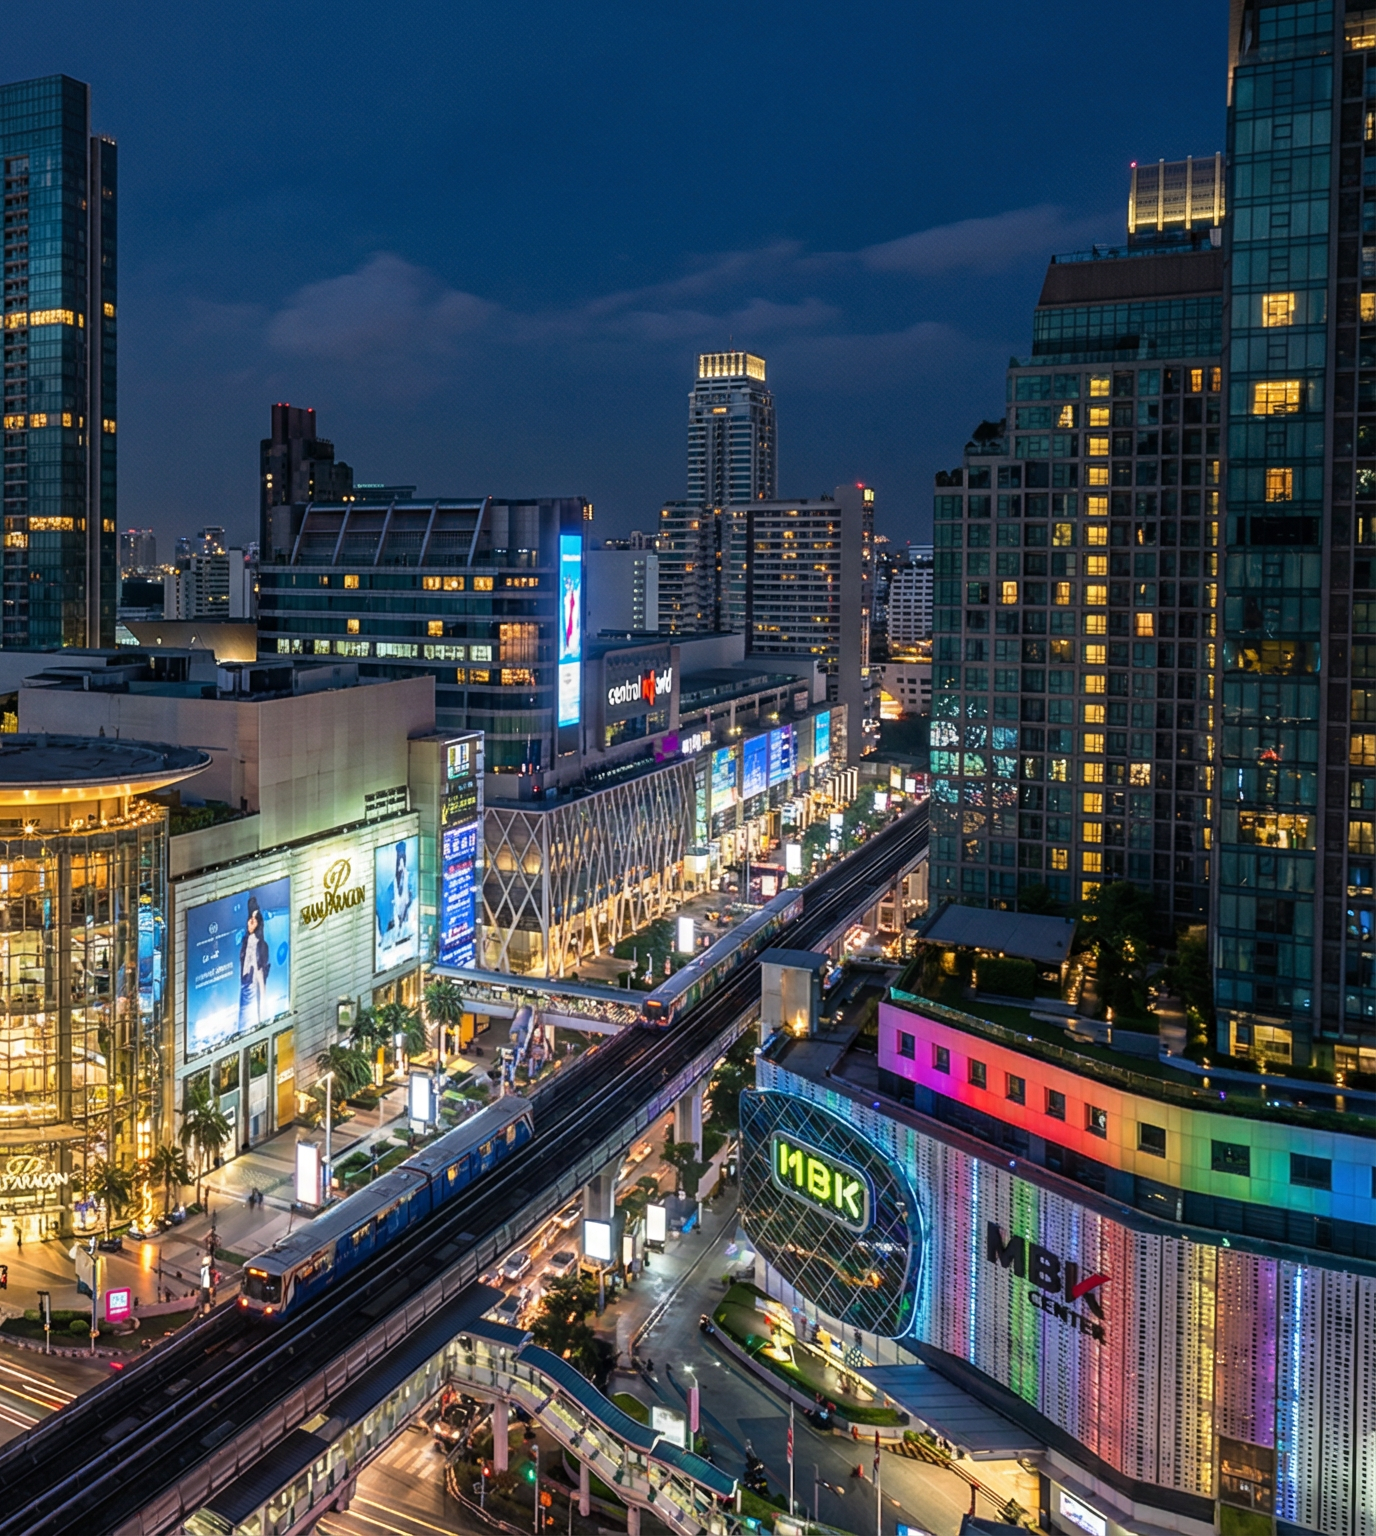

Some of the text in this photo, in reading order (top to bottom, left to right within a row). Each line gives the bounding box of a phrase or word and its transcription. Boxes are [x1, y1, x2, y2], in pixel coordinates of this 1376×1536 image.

[780, 1143, 859, 1219] MBK
[987, 1220, 1112, 1320] MBK
[1028, 1290, 1106, 1346] CENTER
